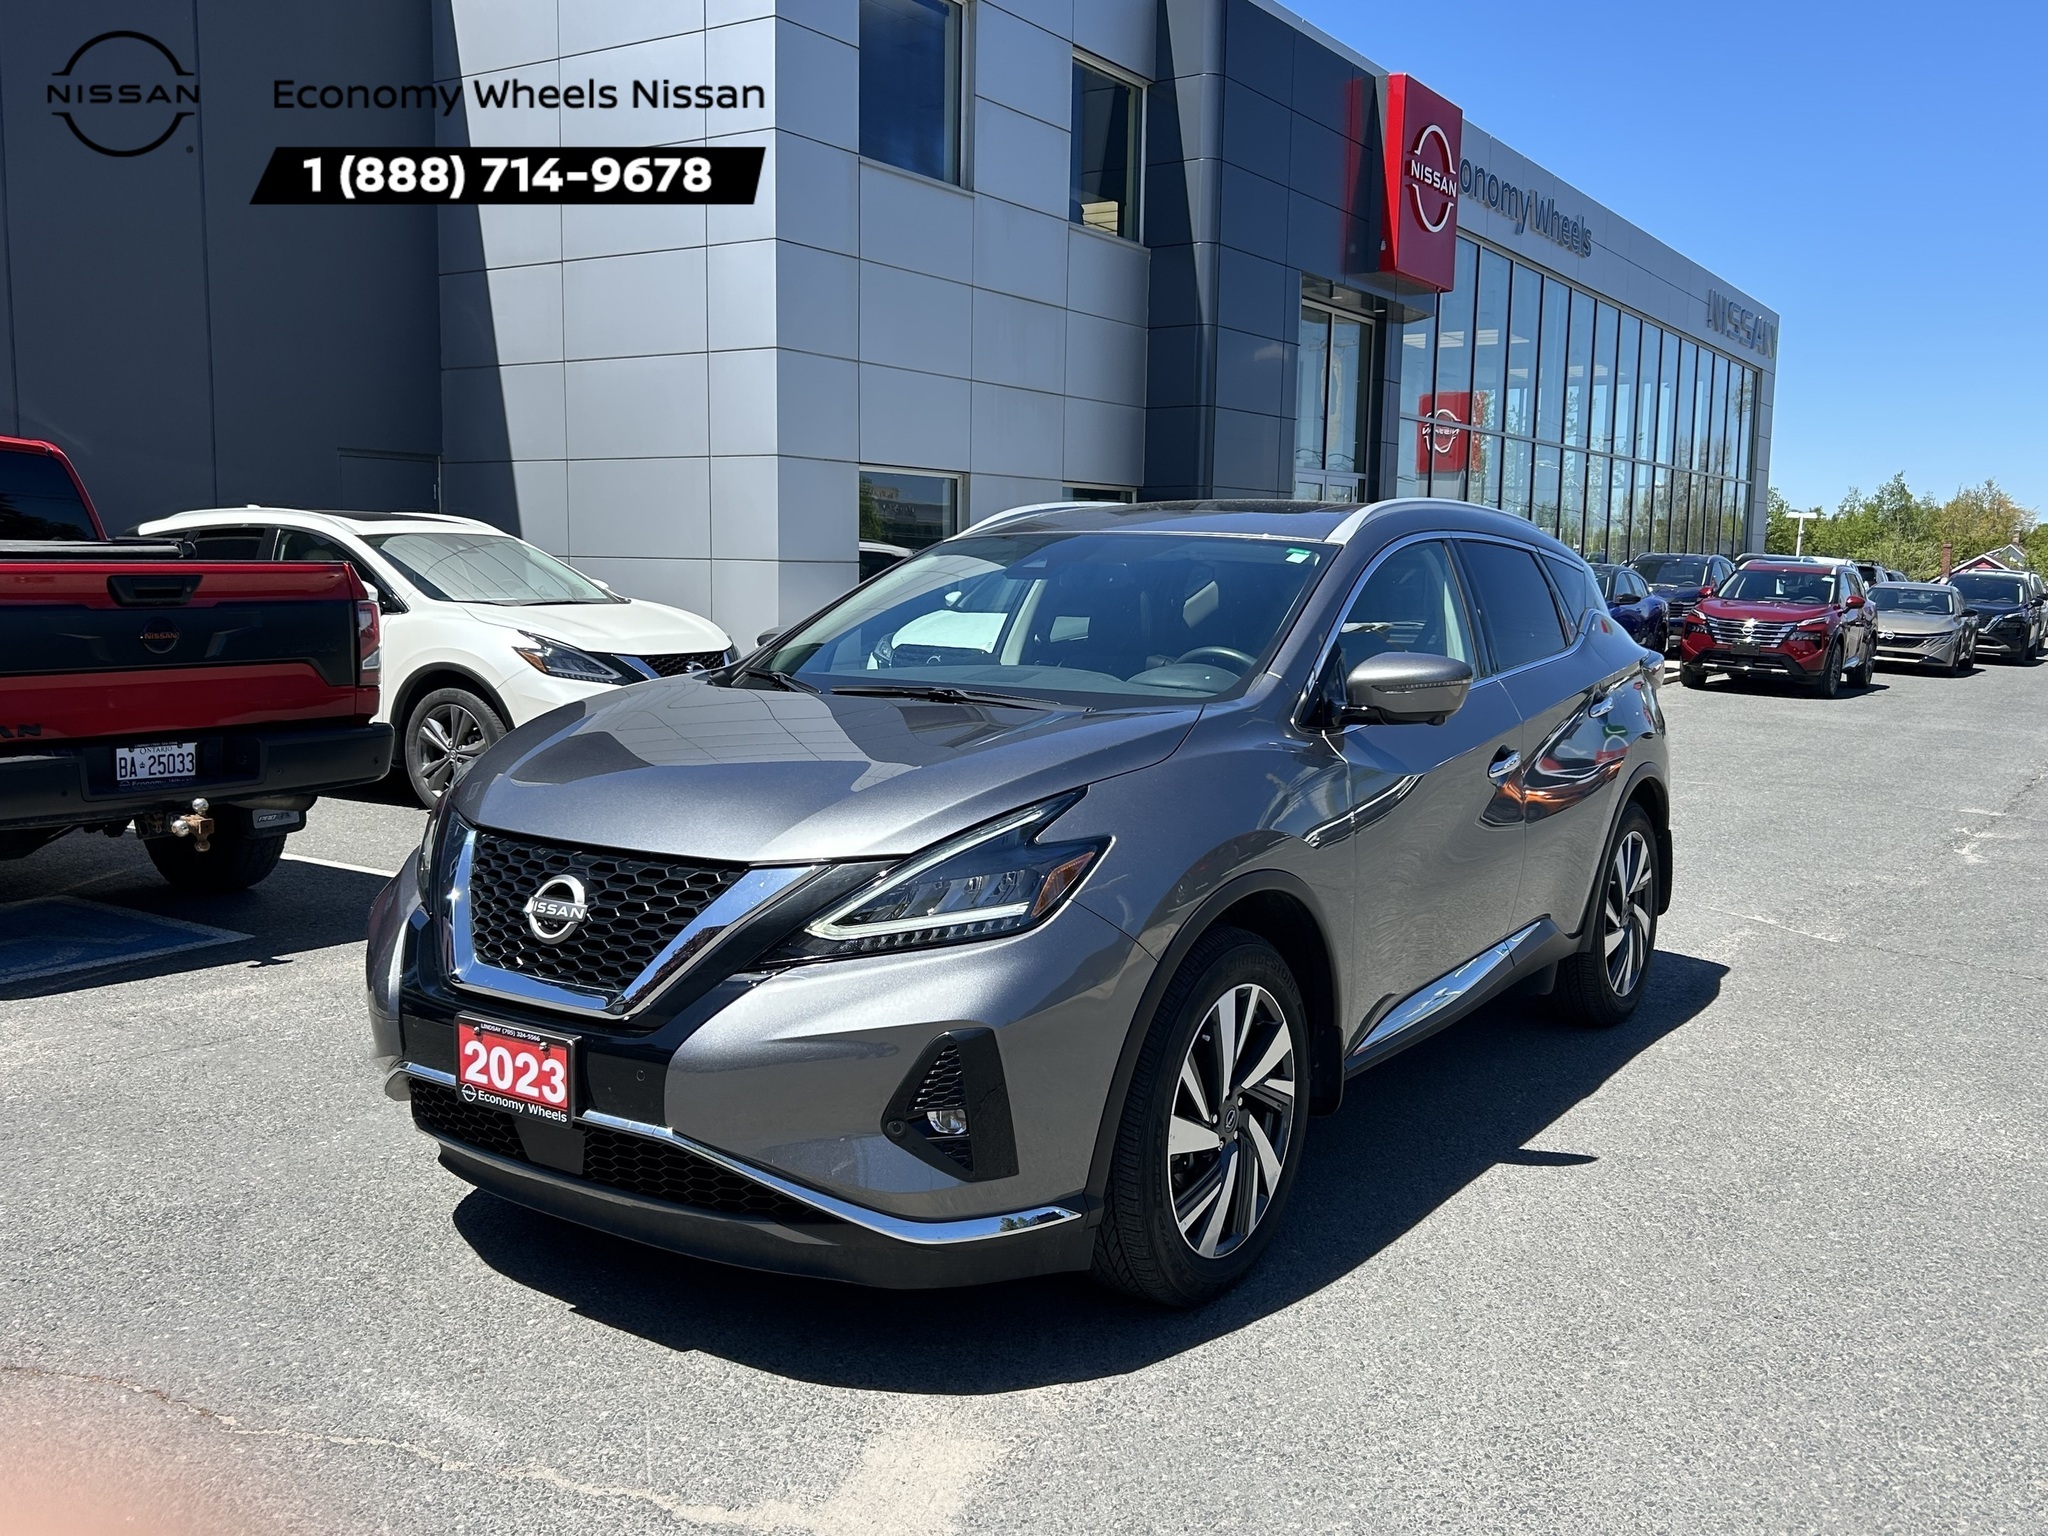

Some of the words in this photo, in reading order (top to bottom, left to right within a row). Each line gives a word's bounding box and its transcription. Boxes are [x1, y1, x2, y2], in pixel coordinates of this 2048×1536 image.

[1410, 159, 1457, 198] NISSAN
[1531, 188, 1592, 258] Wheels
[1707, 288, 1776, 359] NISSAN
[143, 632, 178, 640] NISSAN
[118, 756, 138, 779] BA
[148, 752, 195, 776] 25033
[140, 746, 173, 755] ONTARIO
[463, 1039, 567, 1104] 2023
[477, 1089, 525, 1113] Economy
[527, 1103, 568, 1123] Wheels
